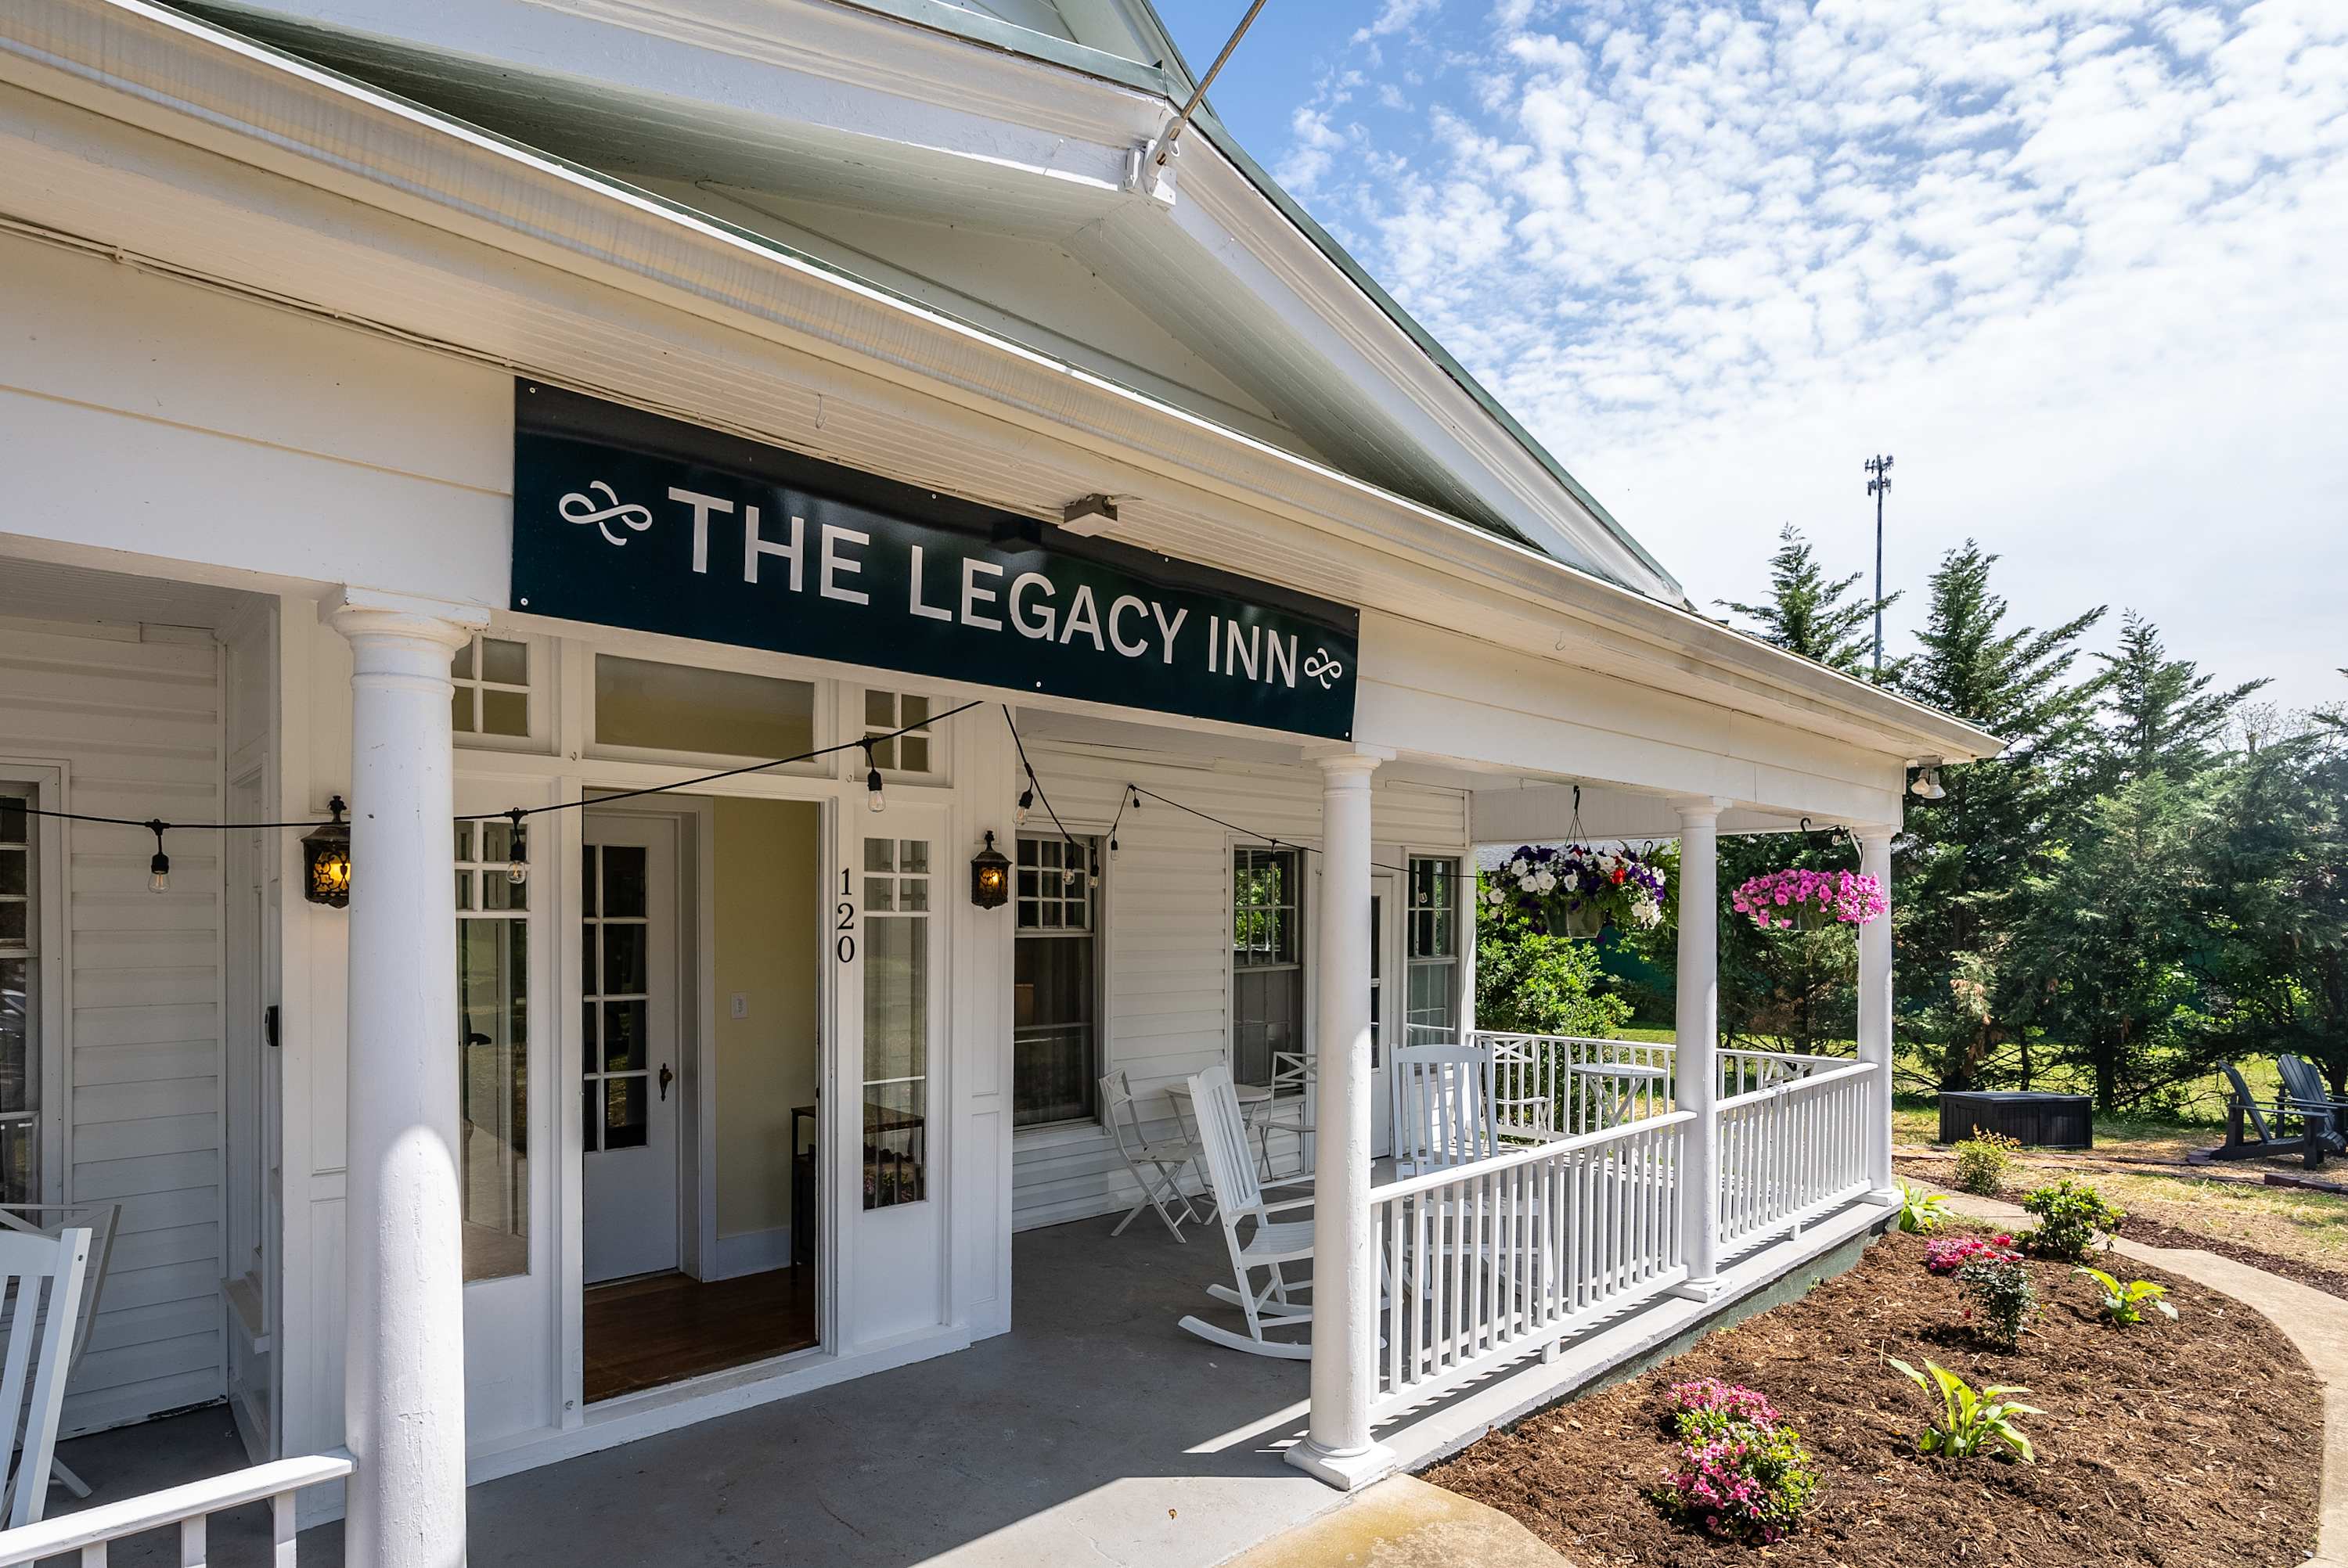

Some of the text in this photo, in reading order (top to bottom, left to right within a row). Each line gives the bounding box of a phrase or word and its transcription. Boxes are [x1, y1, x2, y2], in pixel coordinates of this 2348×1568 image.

[668, 486, 1298, 689] THE LEGACY INN
[837, 867, 855, 963] 120
